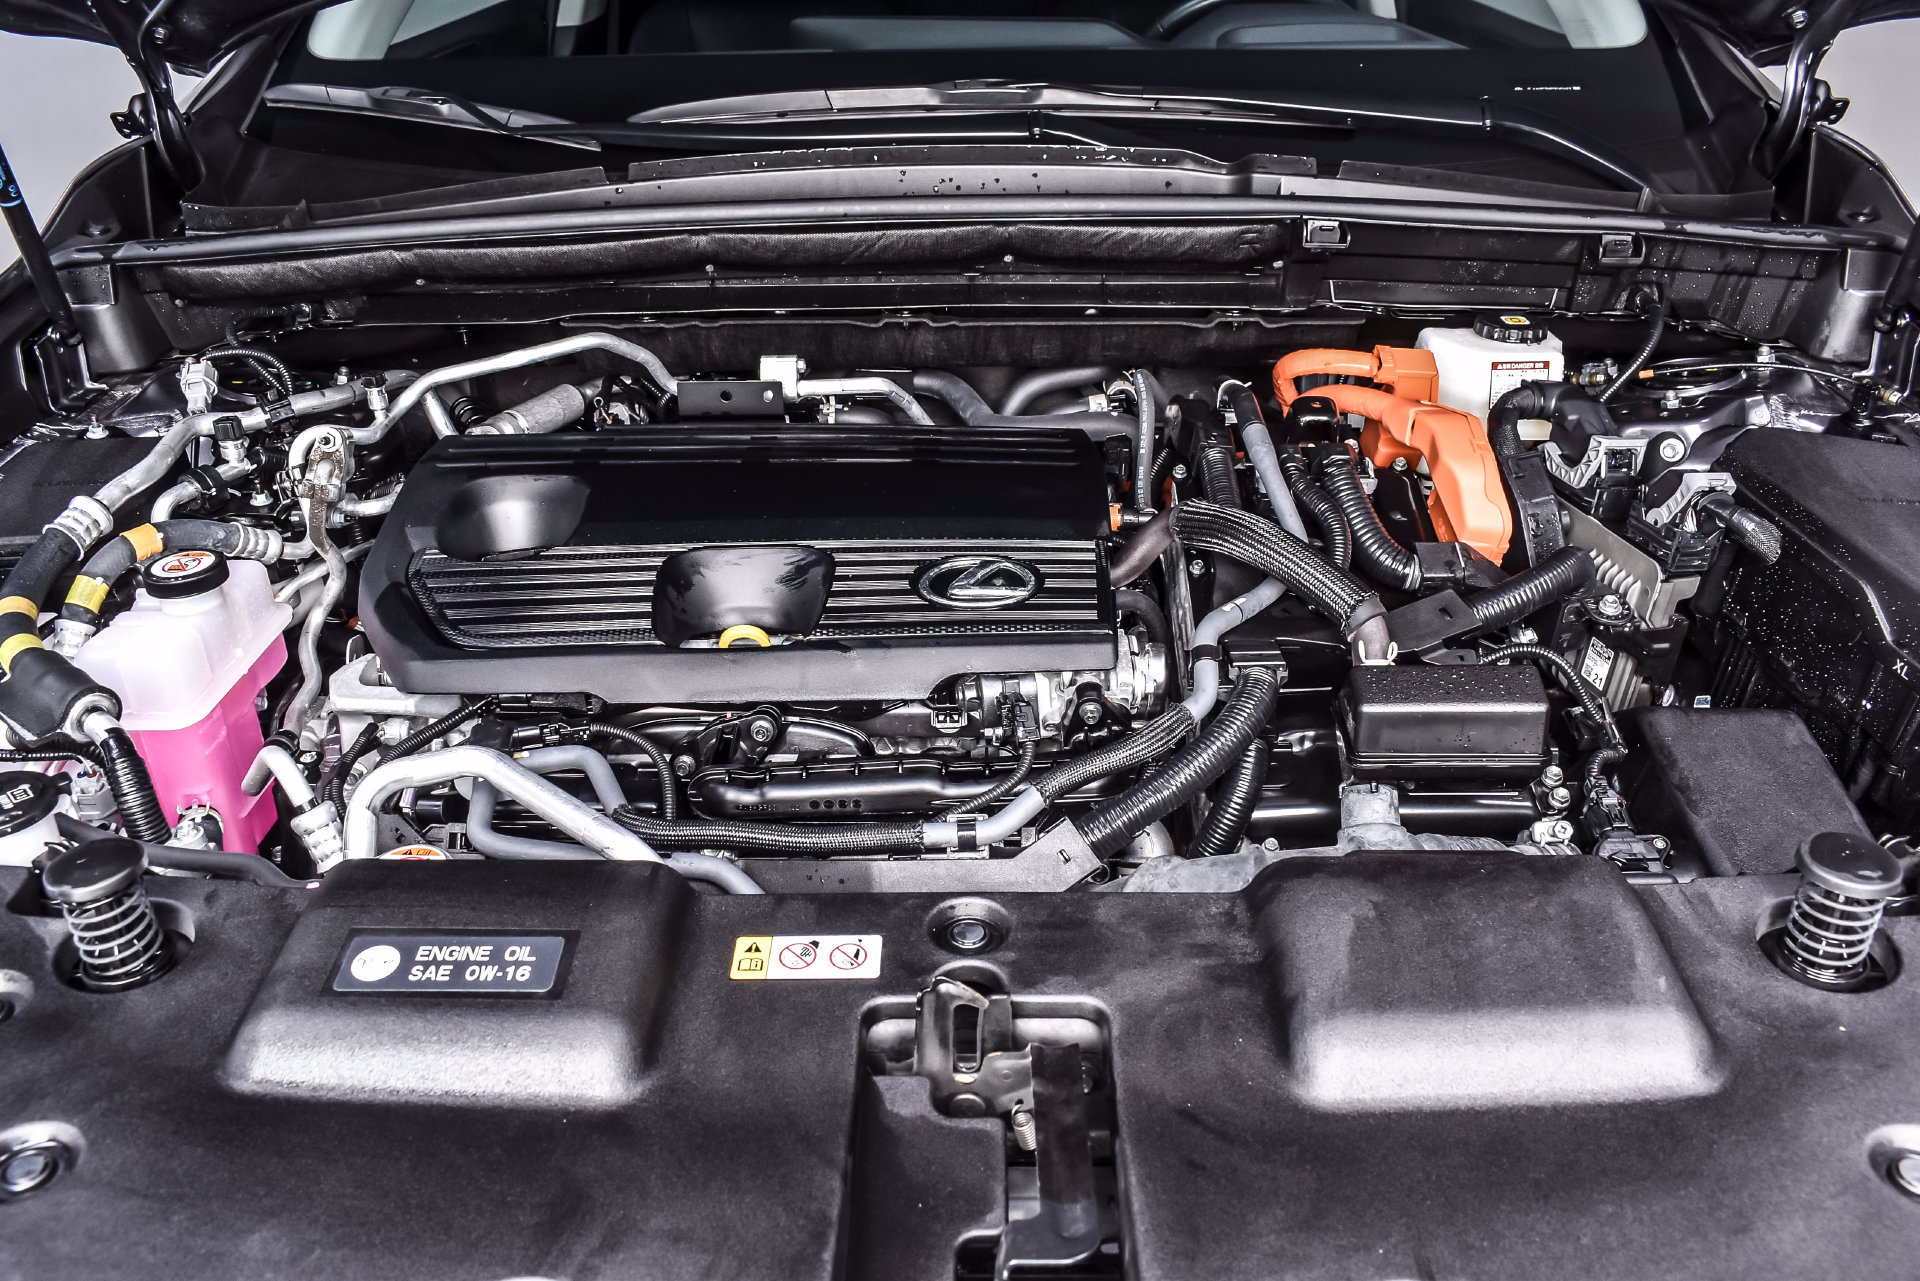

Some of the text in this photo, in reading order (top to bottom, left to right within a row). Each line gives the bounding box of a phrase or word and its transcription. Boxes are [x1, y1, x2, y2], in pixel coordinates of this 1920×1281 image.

[1892, 659, 1909, 680] XL
[1592, 673, 1604, 688] 21
[415, 945, 536, 961] ENGINE OIL
[408, 965, 532, 981] SAE 0W-16
